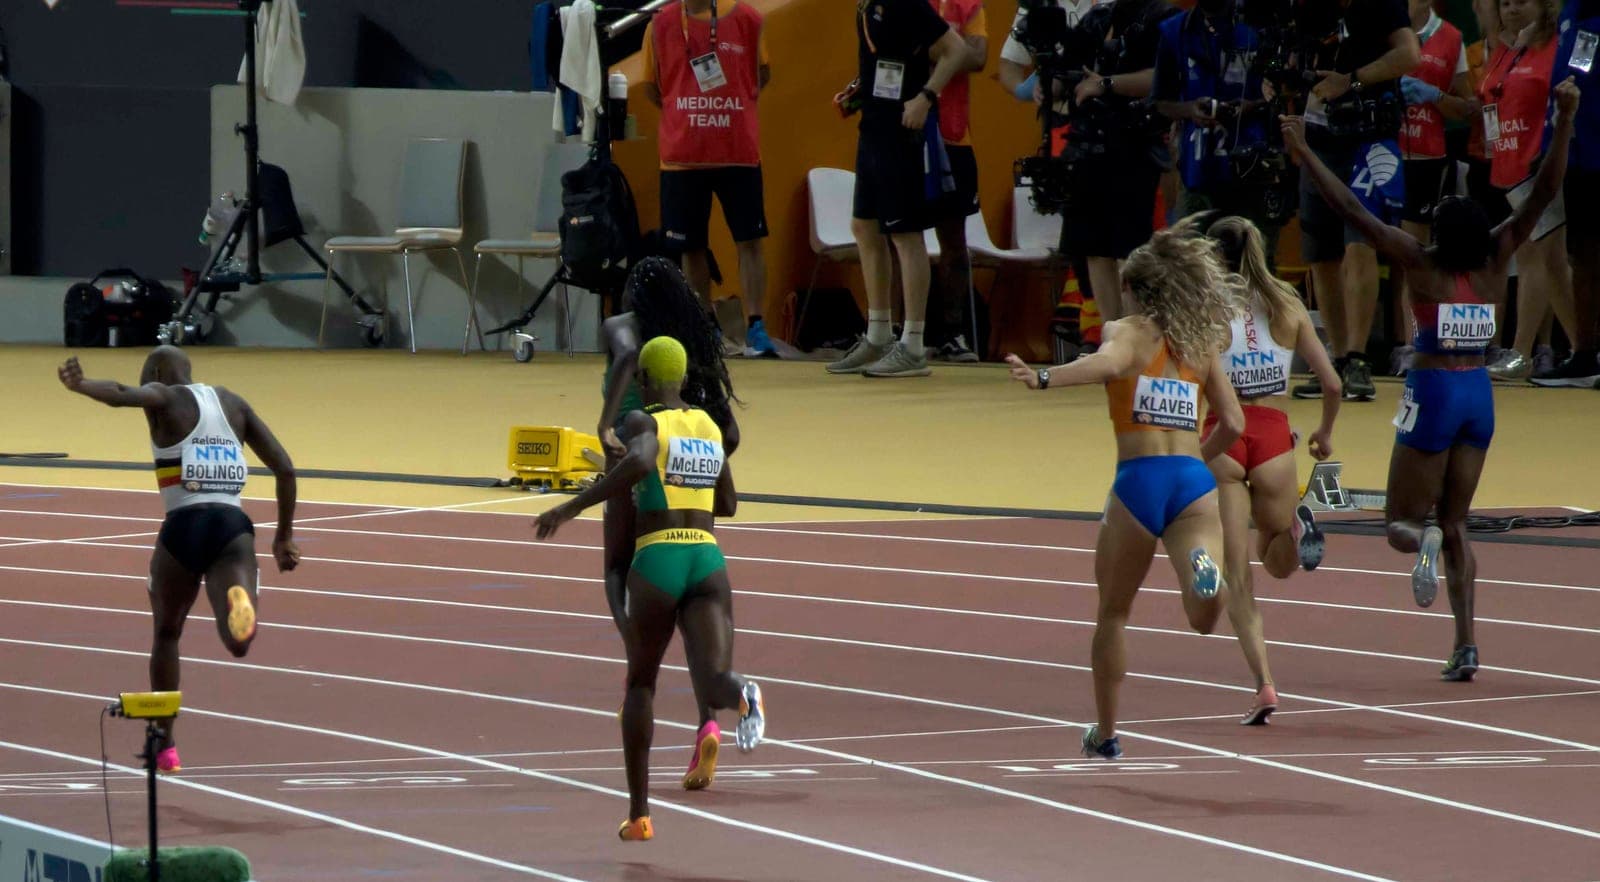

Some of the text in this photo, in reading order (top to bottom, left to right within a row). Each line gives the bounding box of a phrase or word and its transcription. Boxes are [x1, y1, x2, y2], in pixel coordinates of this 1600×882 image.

[676, 97, 744, 110] MEDICAL
[688, 114, 731, 127] TEAM
[1452, 305, 1490, 319] NTN
[1442, 322, 1494, 337] PAULINO
[1231, 350, 1275, 367] NTN
[1227, 364, 1284, 385] ACZMAREK
[1151, 379, 1189, 397] NTN
[1139, 395, 1194, 416] KLAVER
[1401, 405, 1411, 424] 7
[195, 445, 237, 461] NTN
[518, 442, 551, 455] SEIKO
[680, 438, 715, 456] NTN
[186, 464, 244, 480] BOLINGO
[671, 457, 720, 474] McLEOD
[664, 531, 705, 541] JAMAICA
